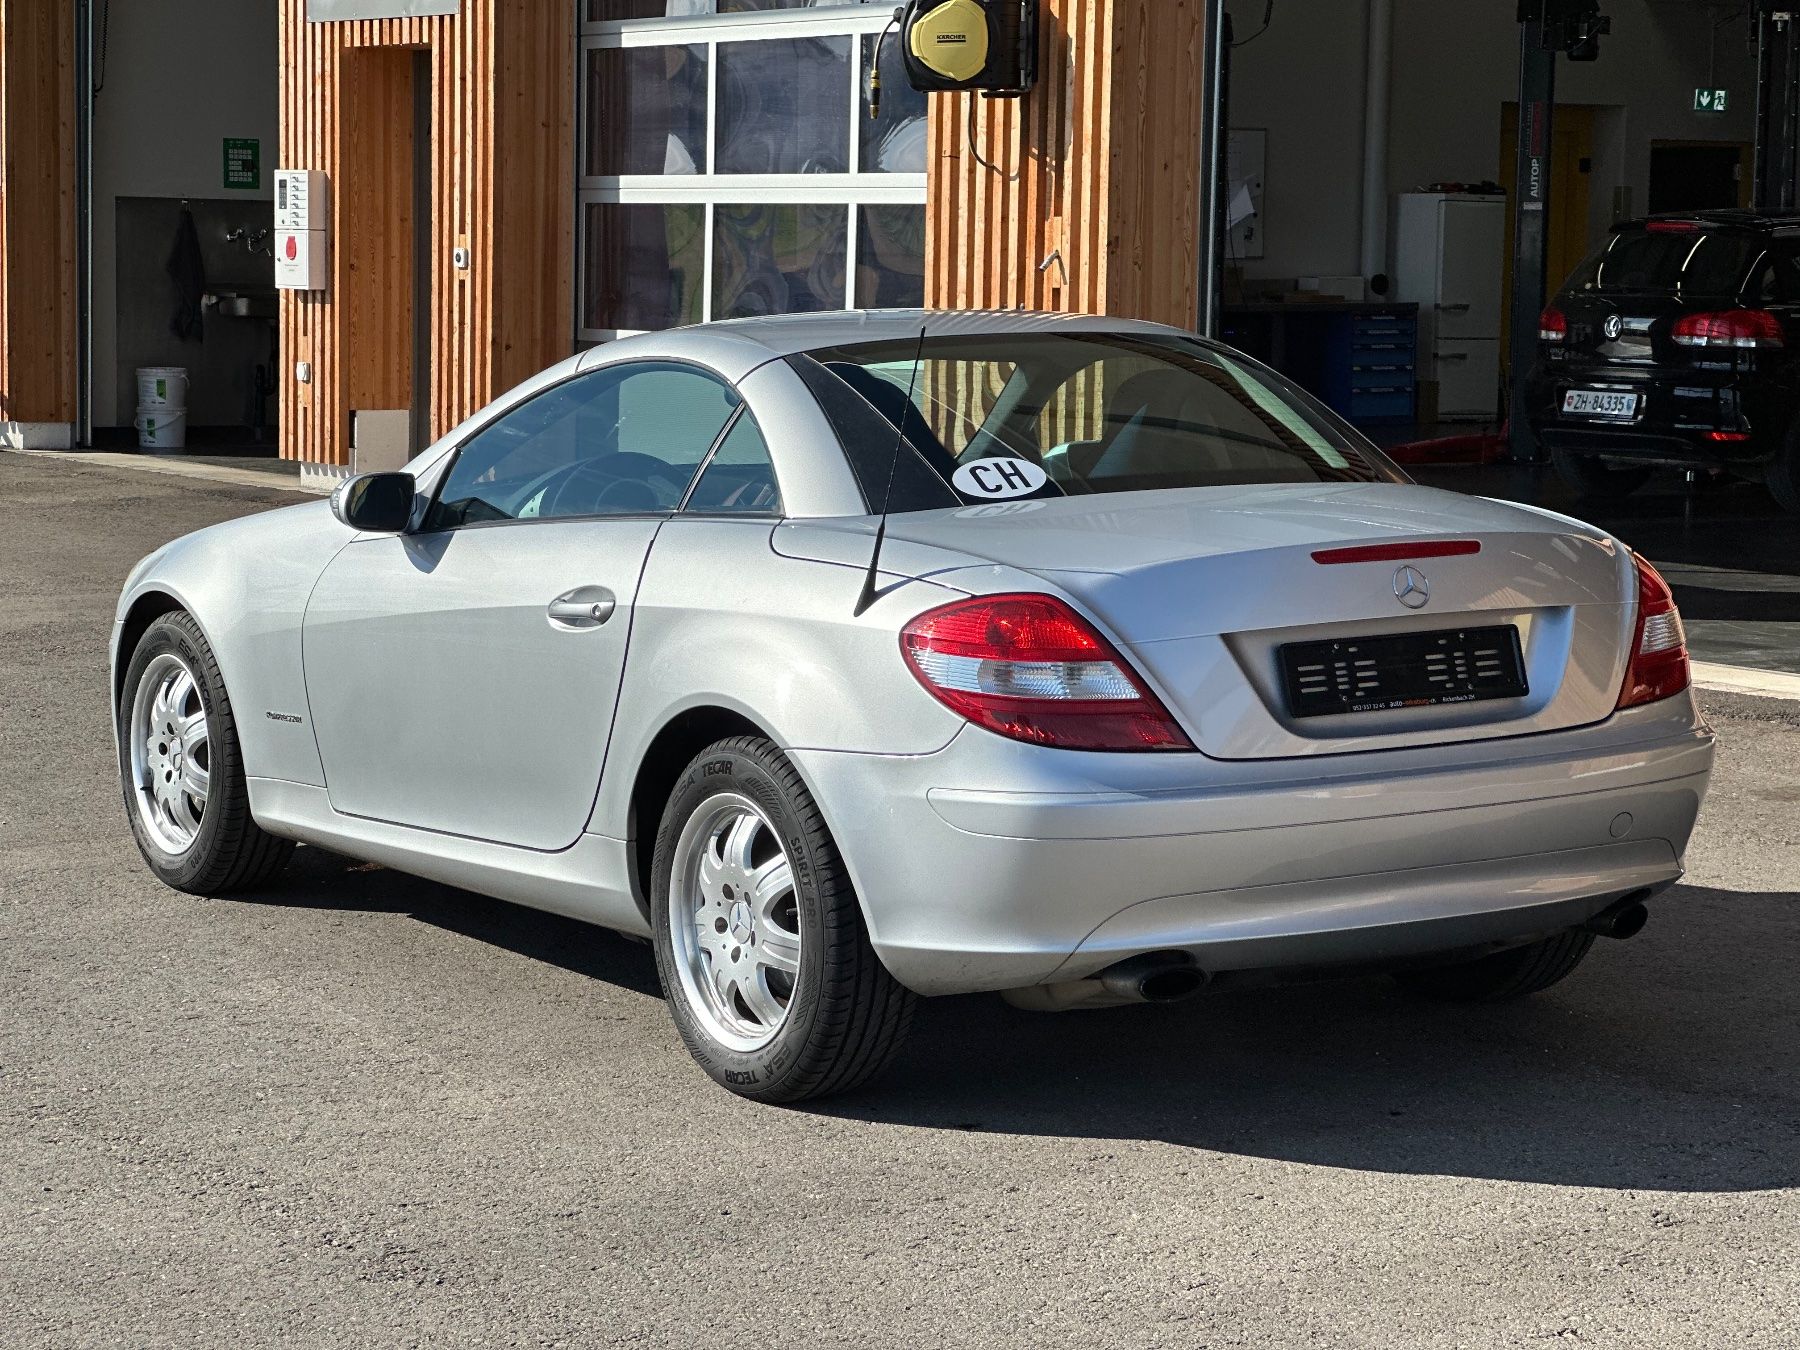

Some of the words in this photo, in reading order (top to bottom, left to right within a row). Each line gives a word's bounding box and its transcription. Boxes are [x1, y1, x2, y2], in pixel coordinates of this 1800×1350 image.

[1530, 158, 1541, 198] AUTOP
[968, 460, 1033, 493] CH
[198, 670, 214, 717] TECAR
[702, 760, 734, 779] TECAR
[790, 836, 812, 888] SPIRIT
[805, 897, 818, 930] PRO
[724, 1068, 761, 1086] TECAR
